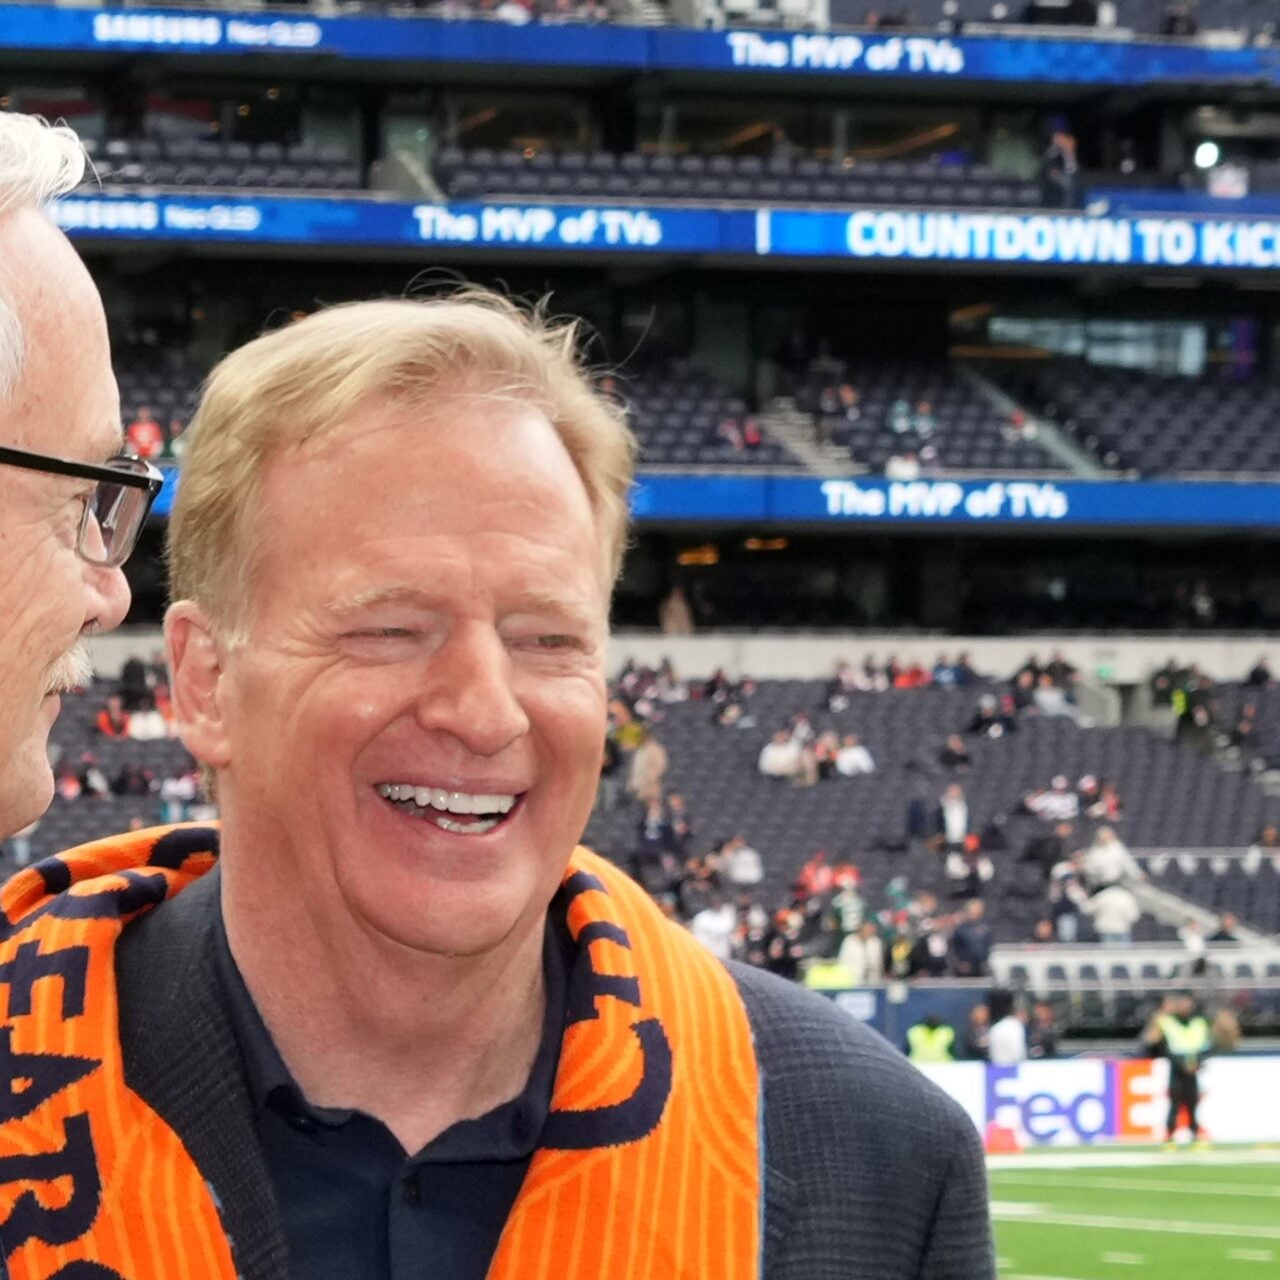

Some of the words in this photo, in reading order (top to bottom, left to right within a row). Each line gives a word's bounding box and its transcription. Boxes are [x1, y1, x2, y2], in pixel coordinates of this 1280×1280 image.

[94, 14, 220, 45] SAMSUNG
[727, 32, 788, 67] The
[792, 34, 863, 69] MVP
[865, 37, 904, 71] of
[904, 38, 964, 73] TVs
[45, 200, 159, 230] AMSUNG
[412, 205, 478, 241] The
[481, 207, 556, 242] MVP
[559, 208, 599, 244] of
[600, 210, 662, 246] TVs
[845, 210, 1132, 262] COUNTDOWN
[1136, 219, 1196, 264] TO
[1202, 221, 1280, 267] KIC
[820, 480, 885, 516] The
[888, 481, 963, 517] MVP
[965, 482, 1004, 517] of
[1006, 483, 1068, 518] TVs
